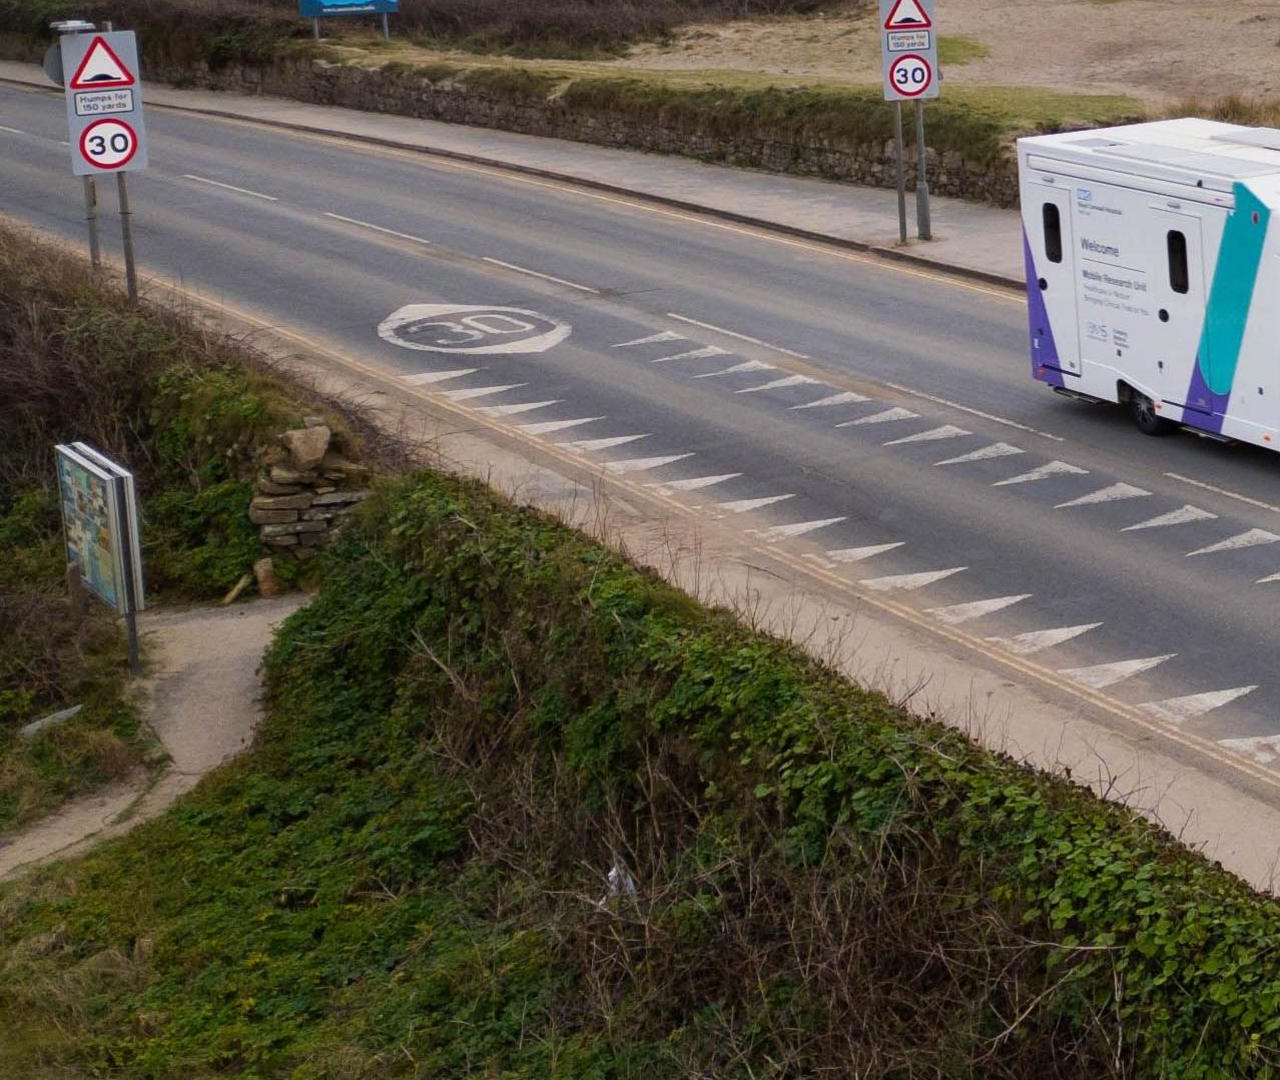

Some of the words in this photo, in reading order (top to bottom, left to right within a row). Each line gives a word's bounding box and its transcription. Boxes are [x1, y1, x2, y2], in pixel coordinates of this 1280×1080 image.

[896, 67, 925, 84] 30
[80, 94, 112, 103] Humps
[83, 103, 99, 112] 150
[102, 102, 127, 111] yards
[89, 133, 129, 155] 30
[1080, 236, 1120, 258] Welcome
[408, 314, 536, 344] 30
